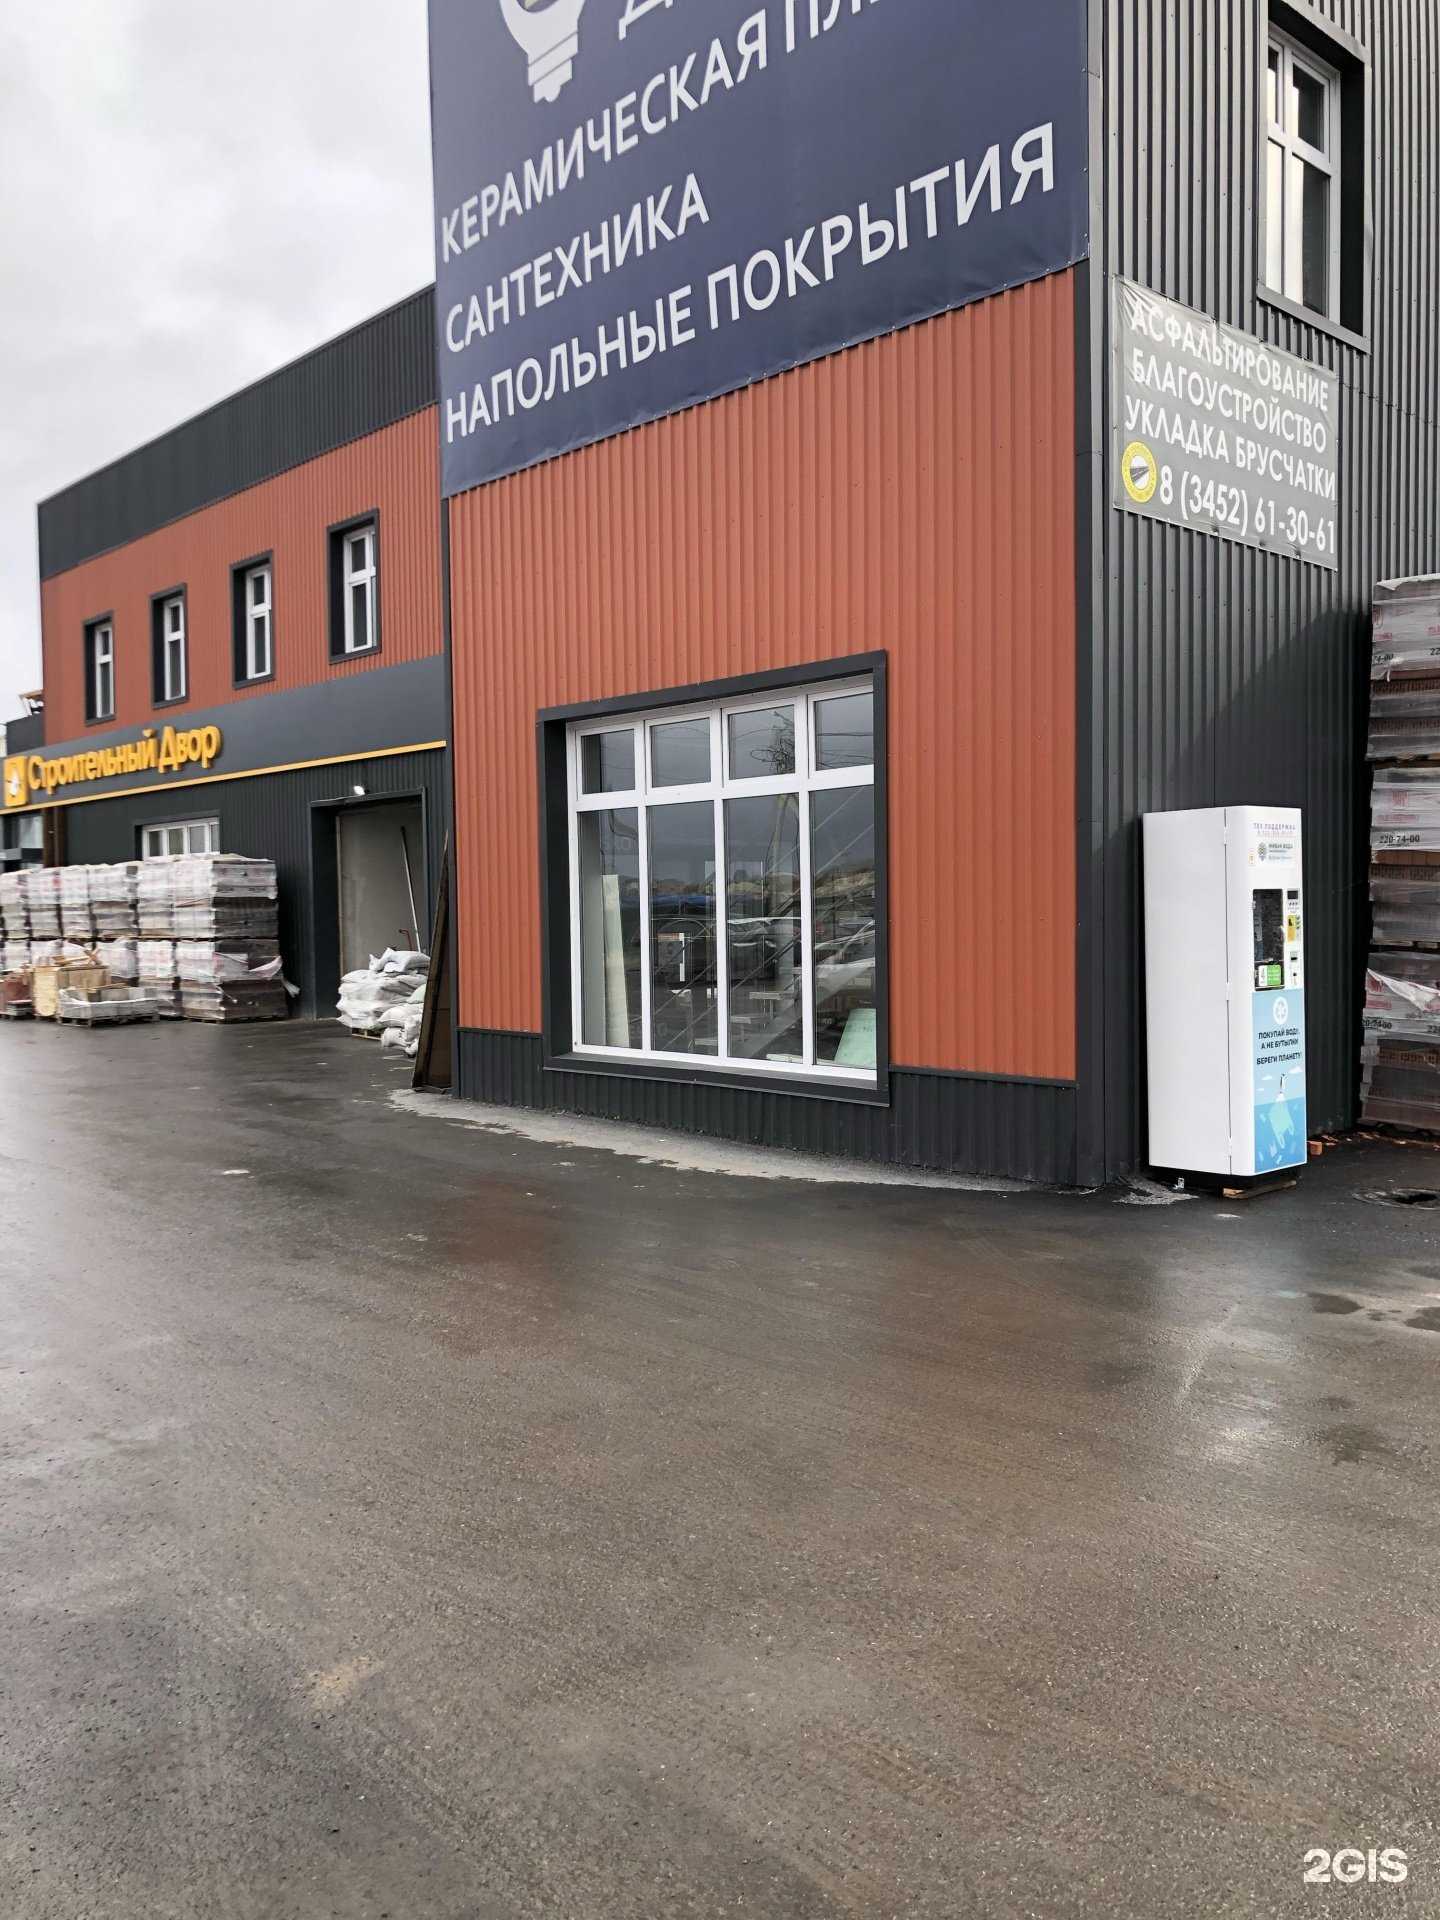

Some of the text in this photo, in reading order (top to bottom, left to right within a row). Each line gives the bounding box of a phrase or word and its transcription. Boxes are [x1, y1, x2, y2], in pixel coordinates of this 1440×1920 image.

[441, 8, 768, 264] КЕРАМИЧЕСКАЯ
[445, 172, 710, 353] САНТЕХНИКА
[445, 122, 1056, 443] НАПОЛЬНЫЕ ПОКРЫТИЯ
[1130, 299, 1328, 412] АСФАЛЬТИРОВАНИЕ
[1132, 349, 1326, 453] БЛАГОУСТРОЙСТВО
[1125, 395, 1336, 501] УКЛАДКА БРУСЧАТКИ
[1159, 465, 1335, 553] 8 (3452) 61-30-61
[27, 725, 221, 794] Строительный Двор
